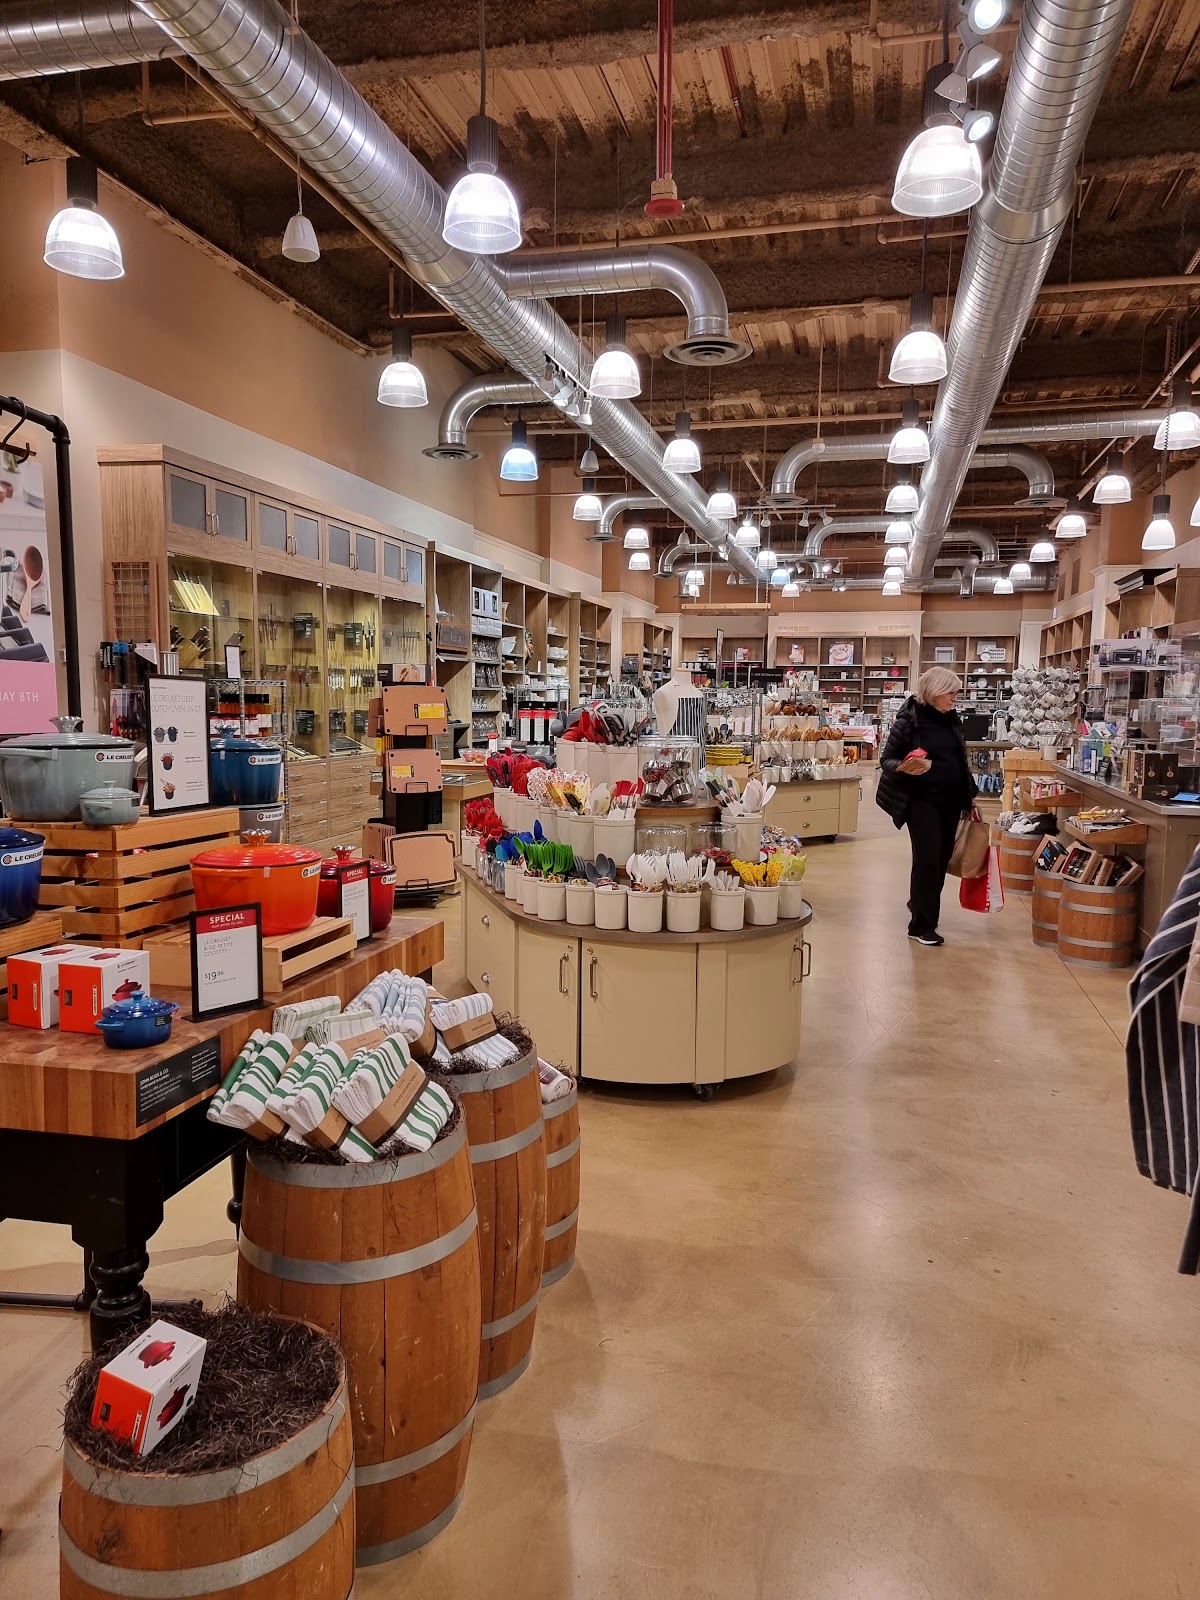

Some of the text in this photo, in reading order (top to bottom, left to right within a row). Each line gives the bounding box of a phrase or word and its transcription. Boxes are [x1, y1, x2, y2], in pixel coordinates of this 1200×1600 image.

[0, 691, 39, 702] AY 8TH
[152, 704, 170, 712] DUTCH
[346, 868, 364, 878] SPECIAL
[210, 912, 244, 924] SPECIAL
[210, 936, 232, 944] CREUSET
[204, 949, 228, 957] COCOTTE
